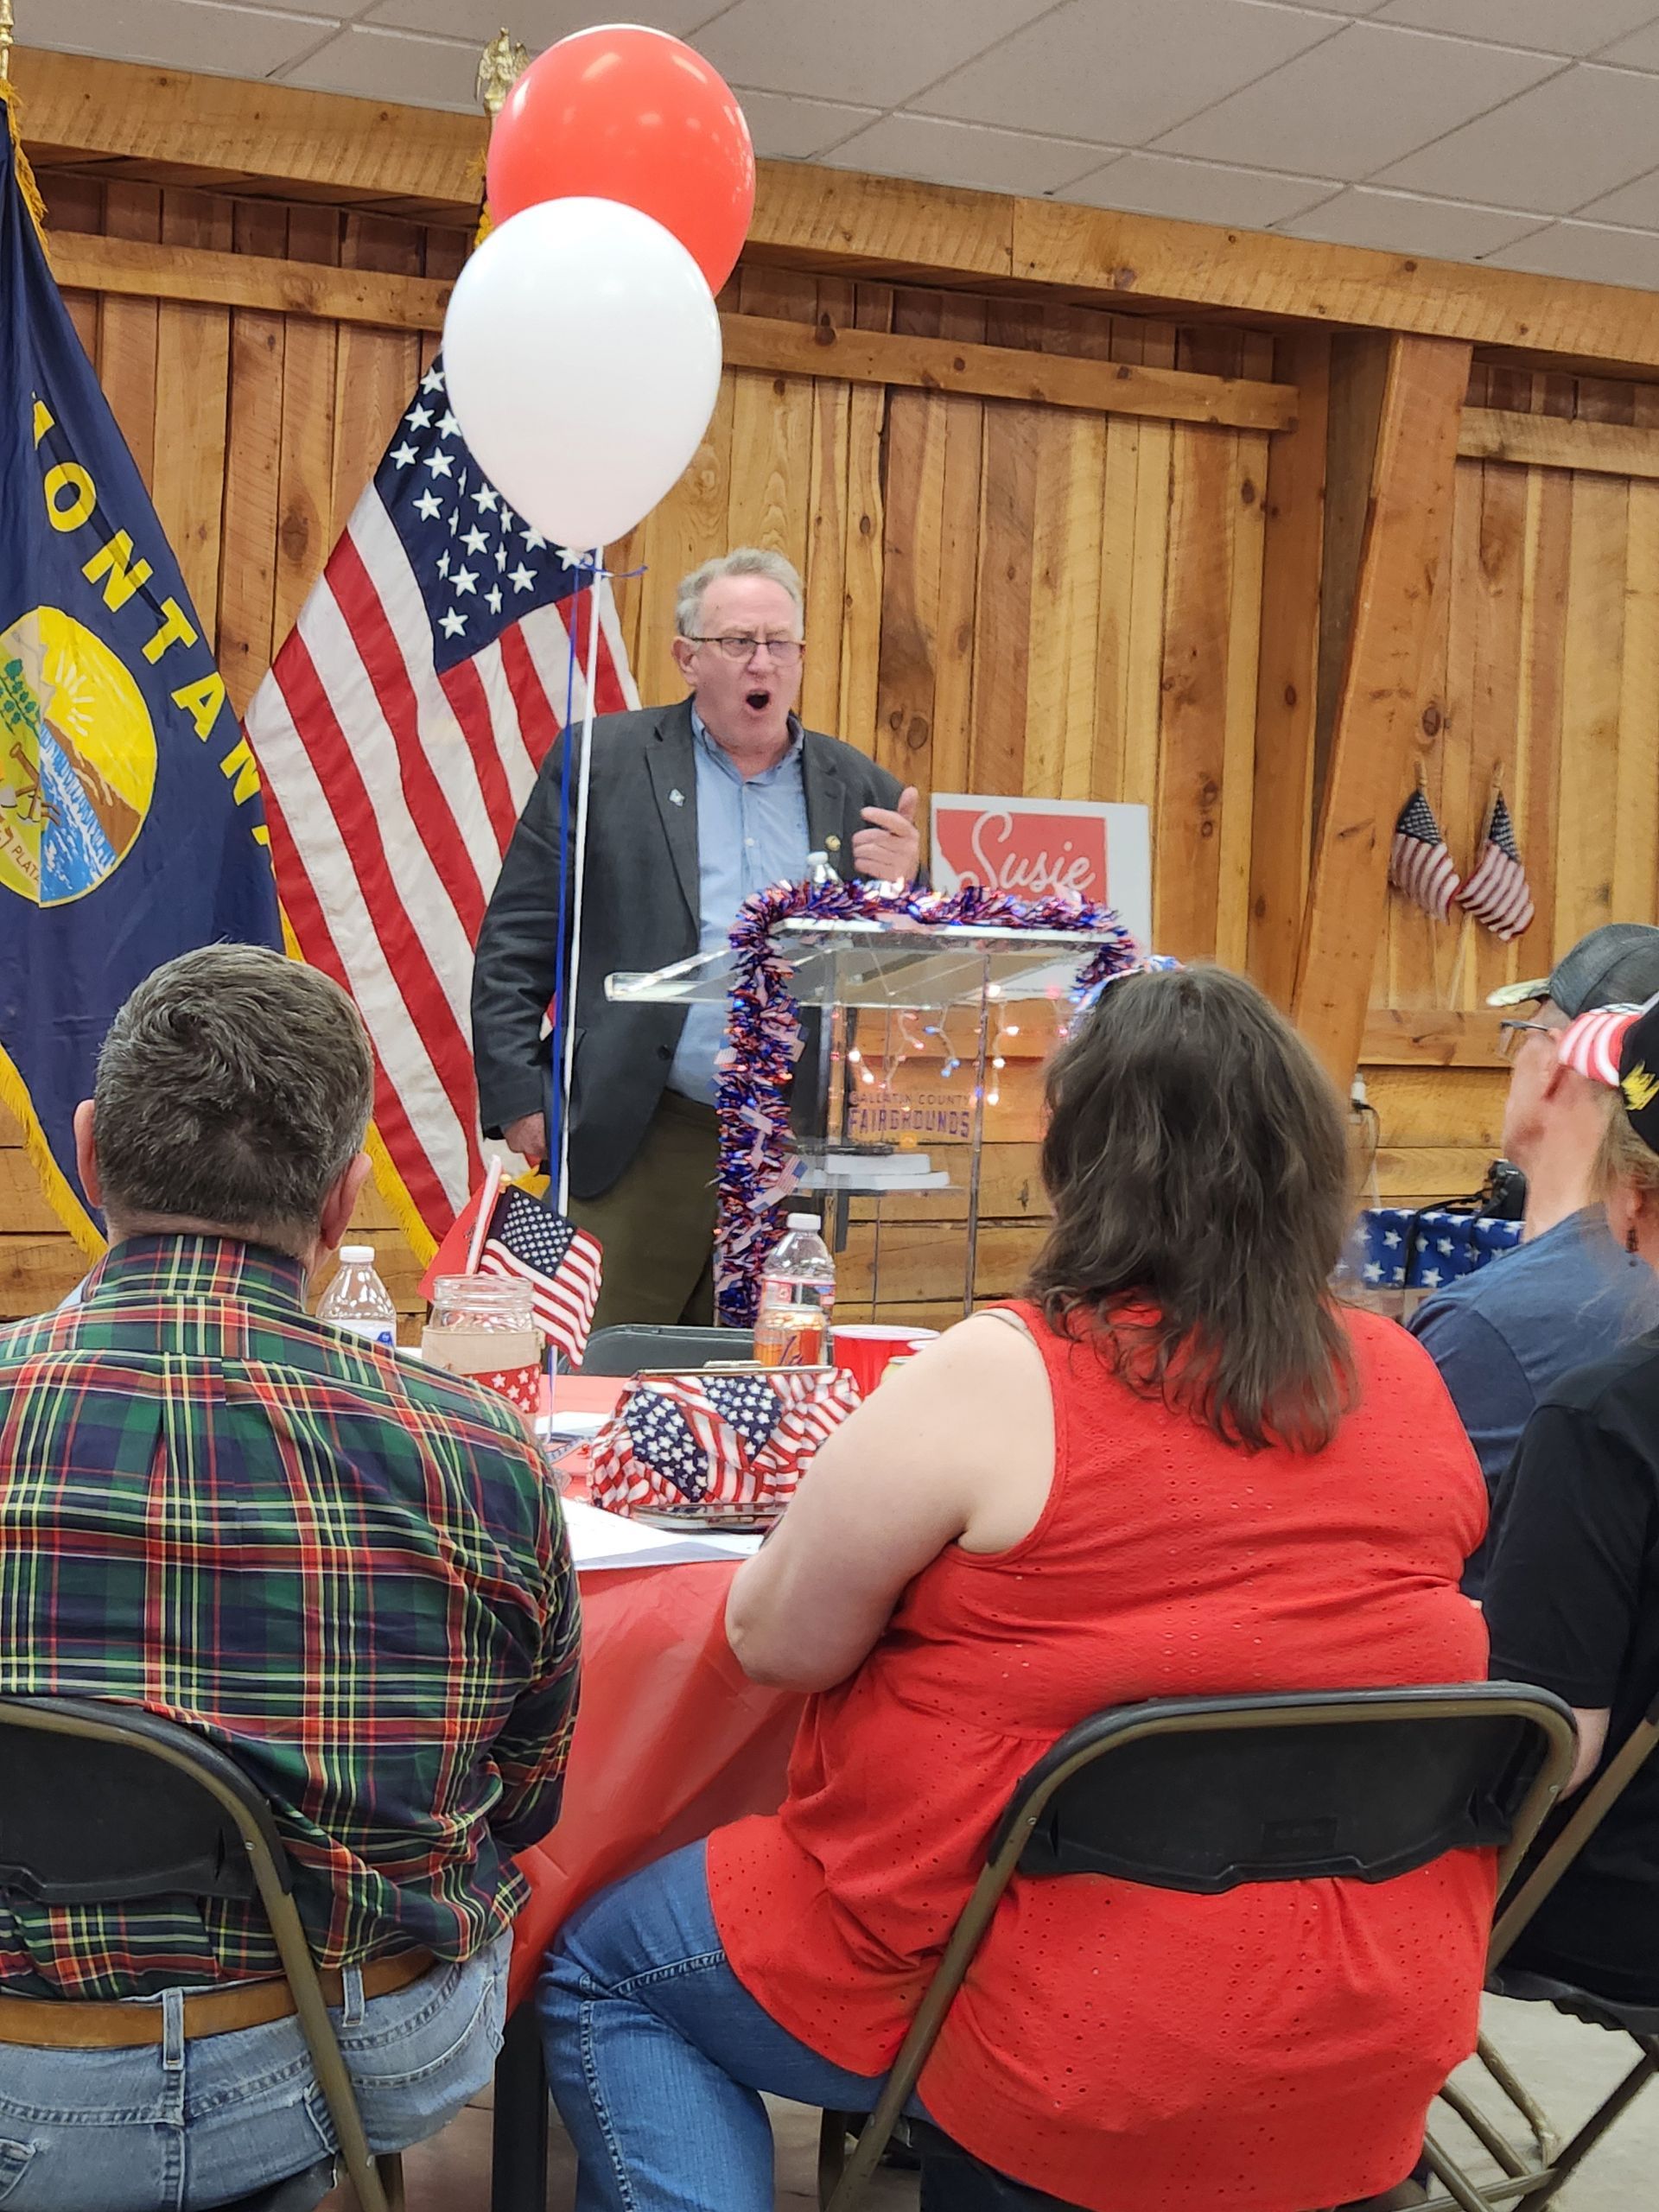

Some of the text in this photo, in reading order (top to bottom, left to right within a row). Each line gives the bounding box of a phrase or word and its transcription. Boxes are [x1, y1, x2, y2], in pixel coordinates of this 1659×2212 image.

[33, 394, 270, 845] ONTAN
[957, 810, 1096, 893] Susie
[848, 1107, 969, 1138] FAIRGROUNDS
[918, 1094, 970, 1105] COUNTY
